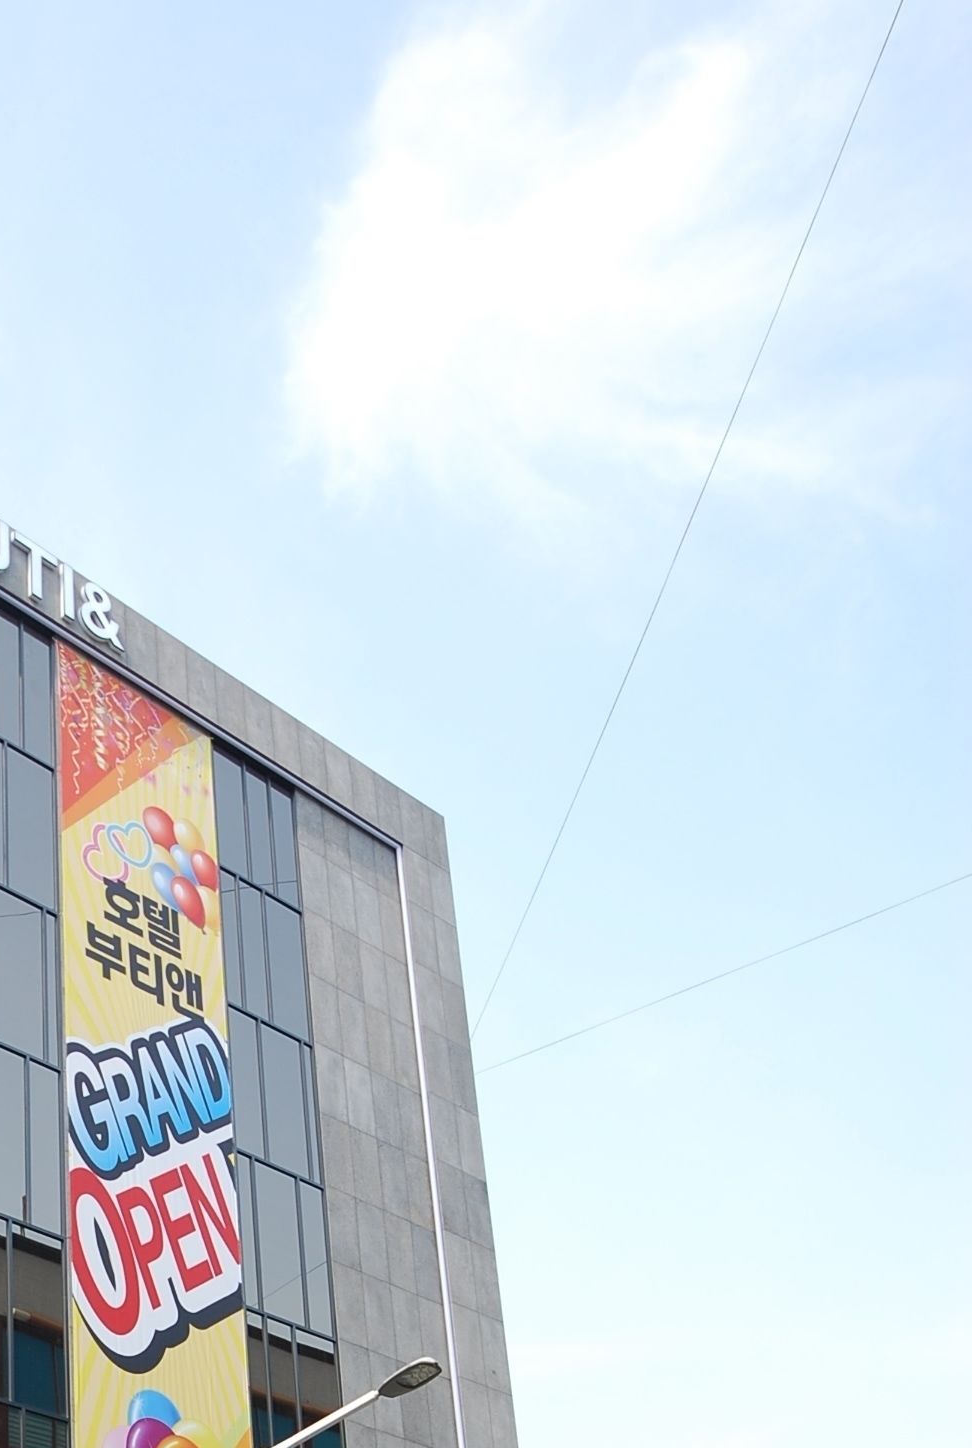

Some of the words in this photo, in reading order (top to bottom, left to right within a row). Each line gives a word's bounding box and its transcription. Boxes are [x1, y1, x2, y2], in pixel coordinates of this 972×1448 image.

[85, 920, 204, 1022] 부티앤
[103, 877, 182, 959] 호텔
[67, 1024, 233, 1174] GRAND
[69, 1153, 241, 1336] OPEN
